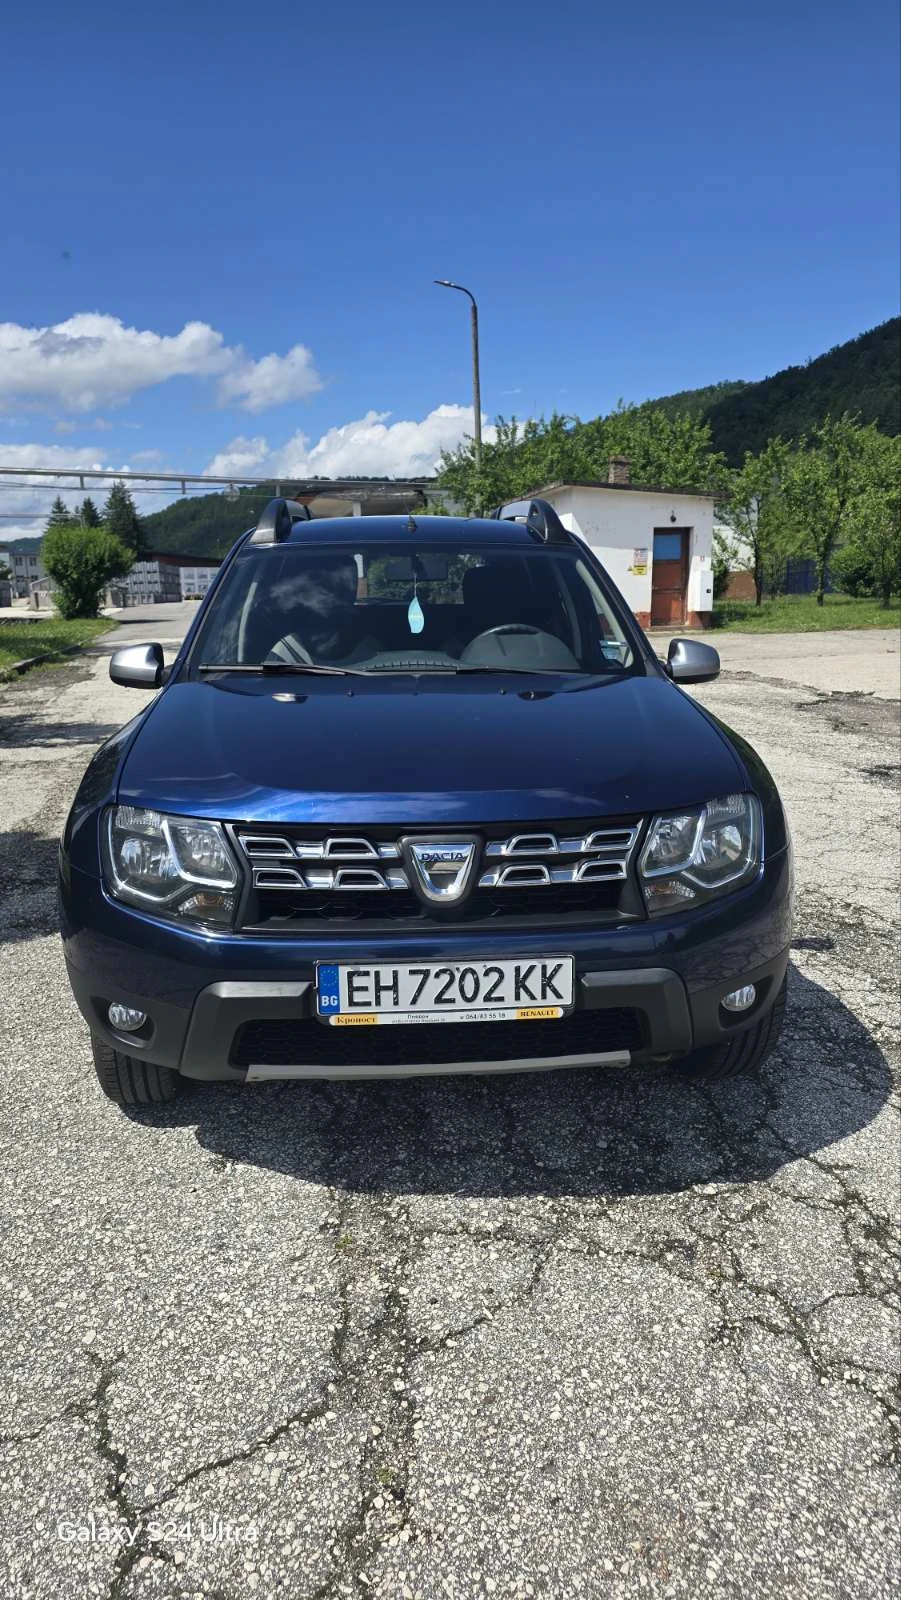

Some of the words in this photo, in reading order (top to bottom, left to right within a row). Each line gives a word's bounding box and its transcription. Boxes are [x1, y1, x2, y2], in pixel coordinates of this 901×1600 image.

[421, 852, 465, 862] DACIA
[347, 968, 399, 1008] EH
[408, 966, 505, 1006] 7202
[514, 963, 564, 1002] KK
[321, 995, 338, 1007] BG
[520, 1009, 555, 1018] RENAULT
